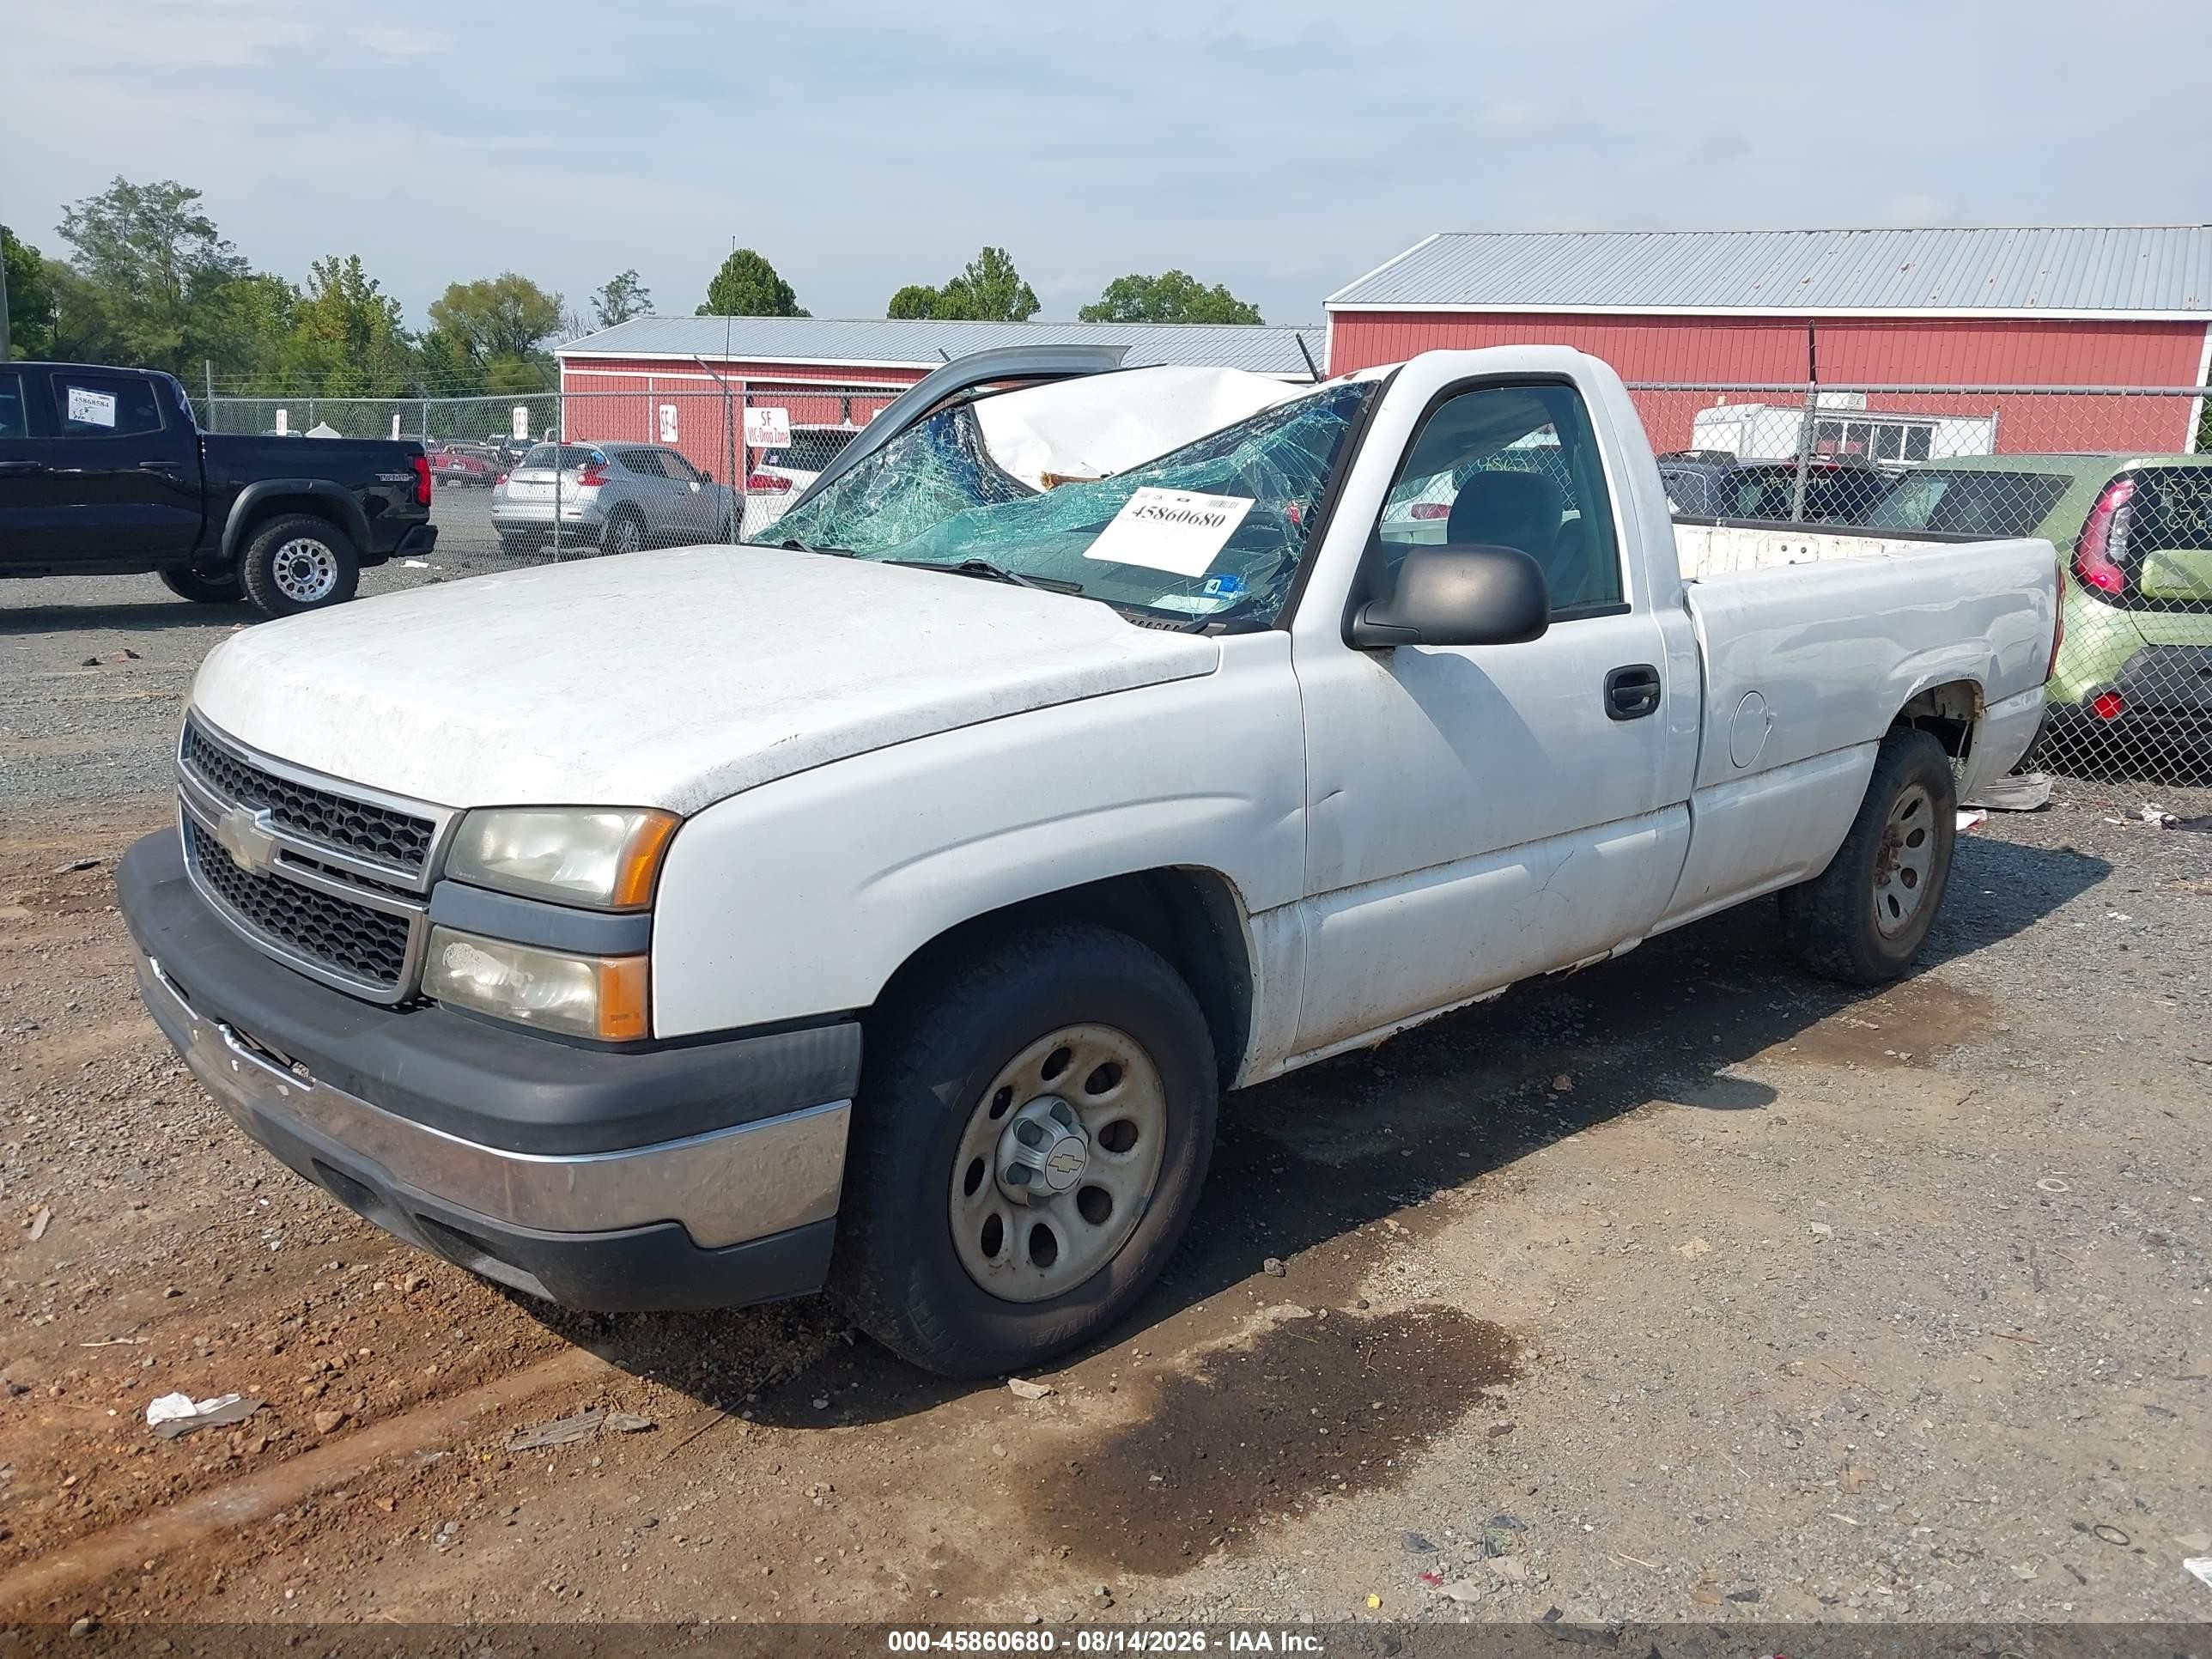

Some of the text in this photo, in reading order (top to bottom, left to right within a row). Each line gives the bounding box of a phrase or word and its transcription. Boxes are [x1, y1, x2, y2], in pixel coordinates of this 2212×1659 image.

[661, 410, 677, 436] SF-4
[761, 411, 771, 427] SF
[747, 427, 790, 446] VIC-Drop Zone
[1133, 505, 1226, 528] 45860680
